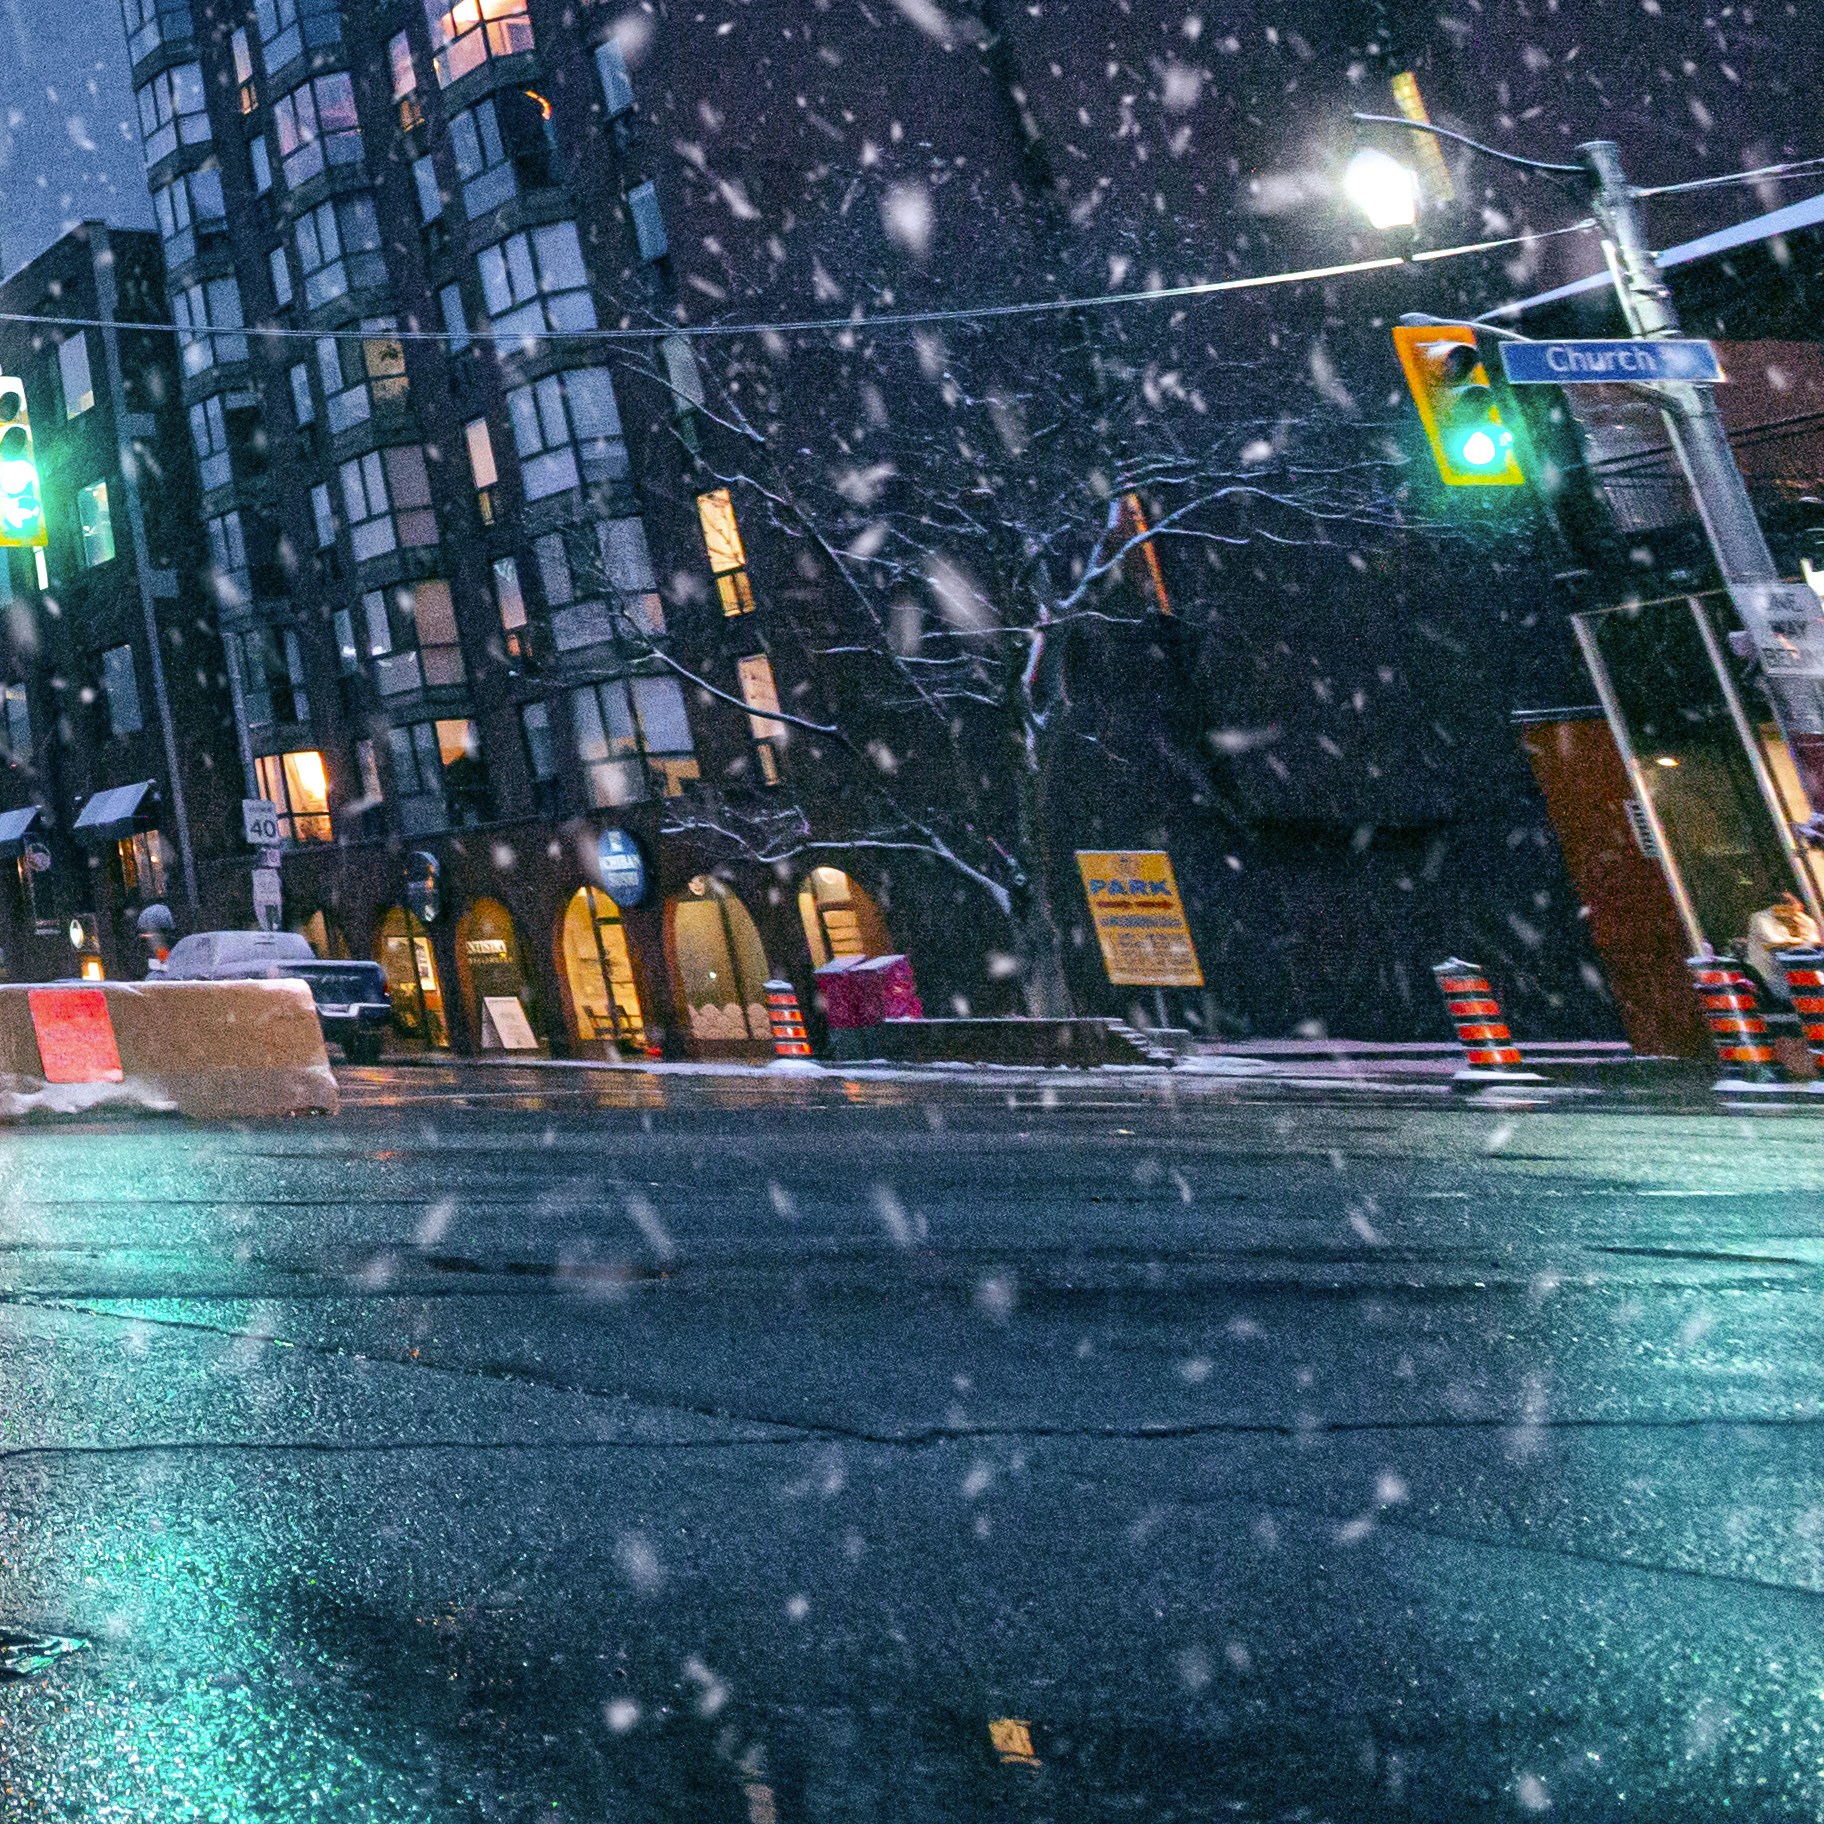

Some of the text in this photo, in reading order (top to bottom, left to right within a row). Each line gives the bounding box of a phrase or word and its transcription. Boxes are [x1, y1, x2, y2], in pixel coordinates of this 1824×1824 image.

[1546, 345, 1656, 372] Church
[250, 819, 277, 838] 40
[1089, 879, 1172, 896] PARK
